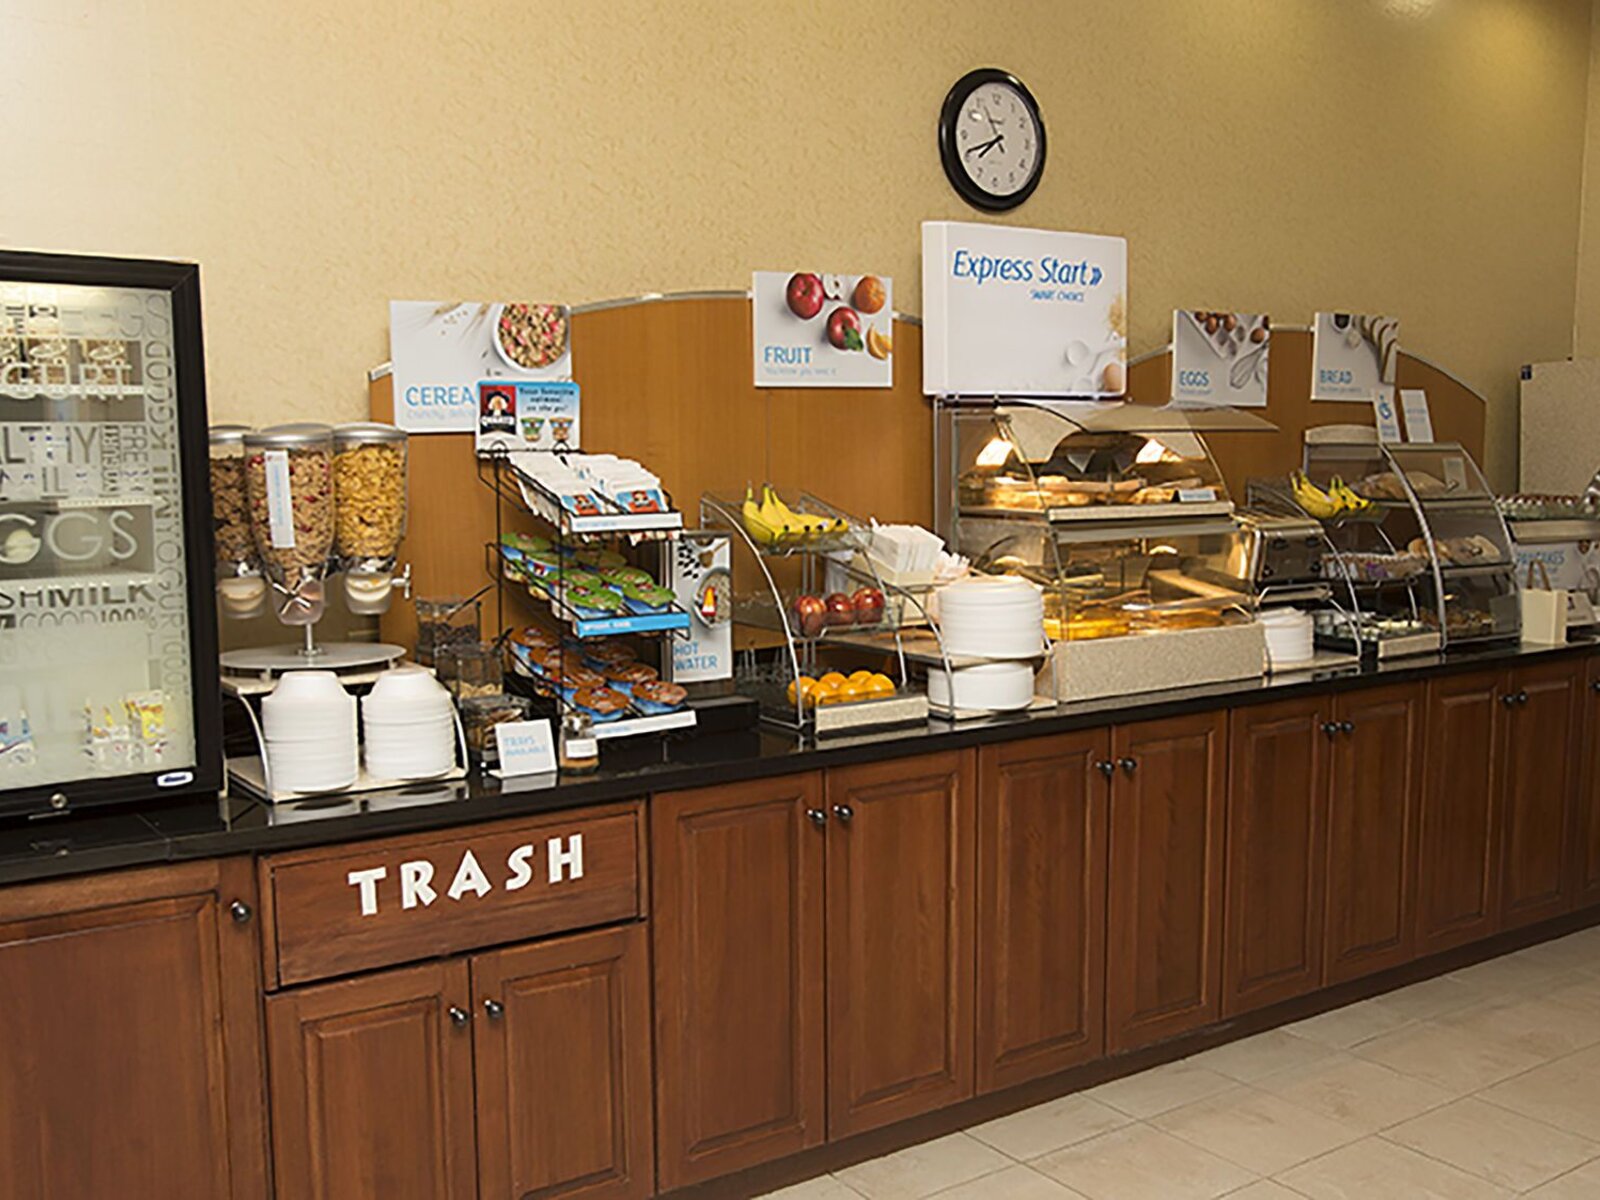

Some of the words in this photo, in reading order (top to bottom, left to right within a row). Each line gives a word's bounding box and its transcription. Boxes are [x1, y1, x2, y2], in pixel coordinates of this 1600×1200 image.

[953, 250, 1034, 285] Express
[1039, 256, 1087, 286] Start
[764, 345, 813, 363] FRUIT
[1180, 370, 1209, 387] EGGS
[405, 385, 476, 407] CEREA
[674, 640, 699, 656] HOT
[674, 654, 718, 671] WATER
[348, 833, 584, 917] TRASH
